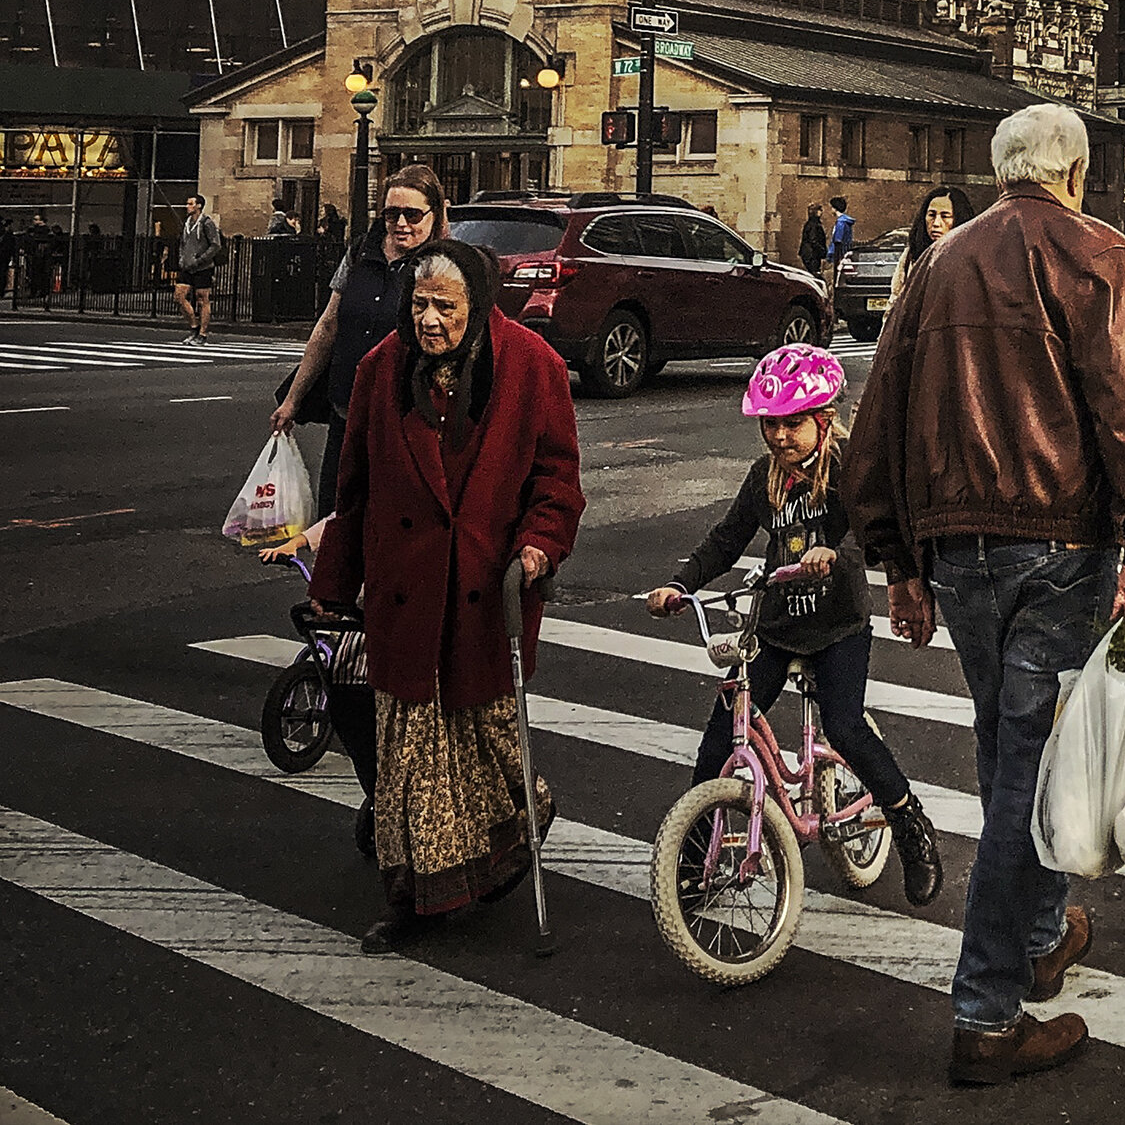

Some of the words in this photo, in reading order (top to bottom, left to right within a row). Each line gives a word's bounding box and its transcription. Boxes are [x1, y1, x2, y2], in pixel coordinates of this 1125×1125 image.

[638, 15, 652, 25] ONE
[657, 18, 670, 27] WAY
[655, 41, 693, 57] BROADWAY
[614, 61, 622, 73] W
[624, 60, 634, 73] 72
[0, 131, 122, 163] PAYA
[771, 498, 798, 529] NEW
[786, 593, 816, 616] CITY
